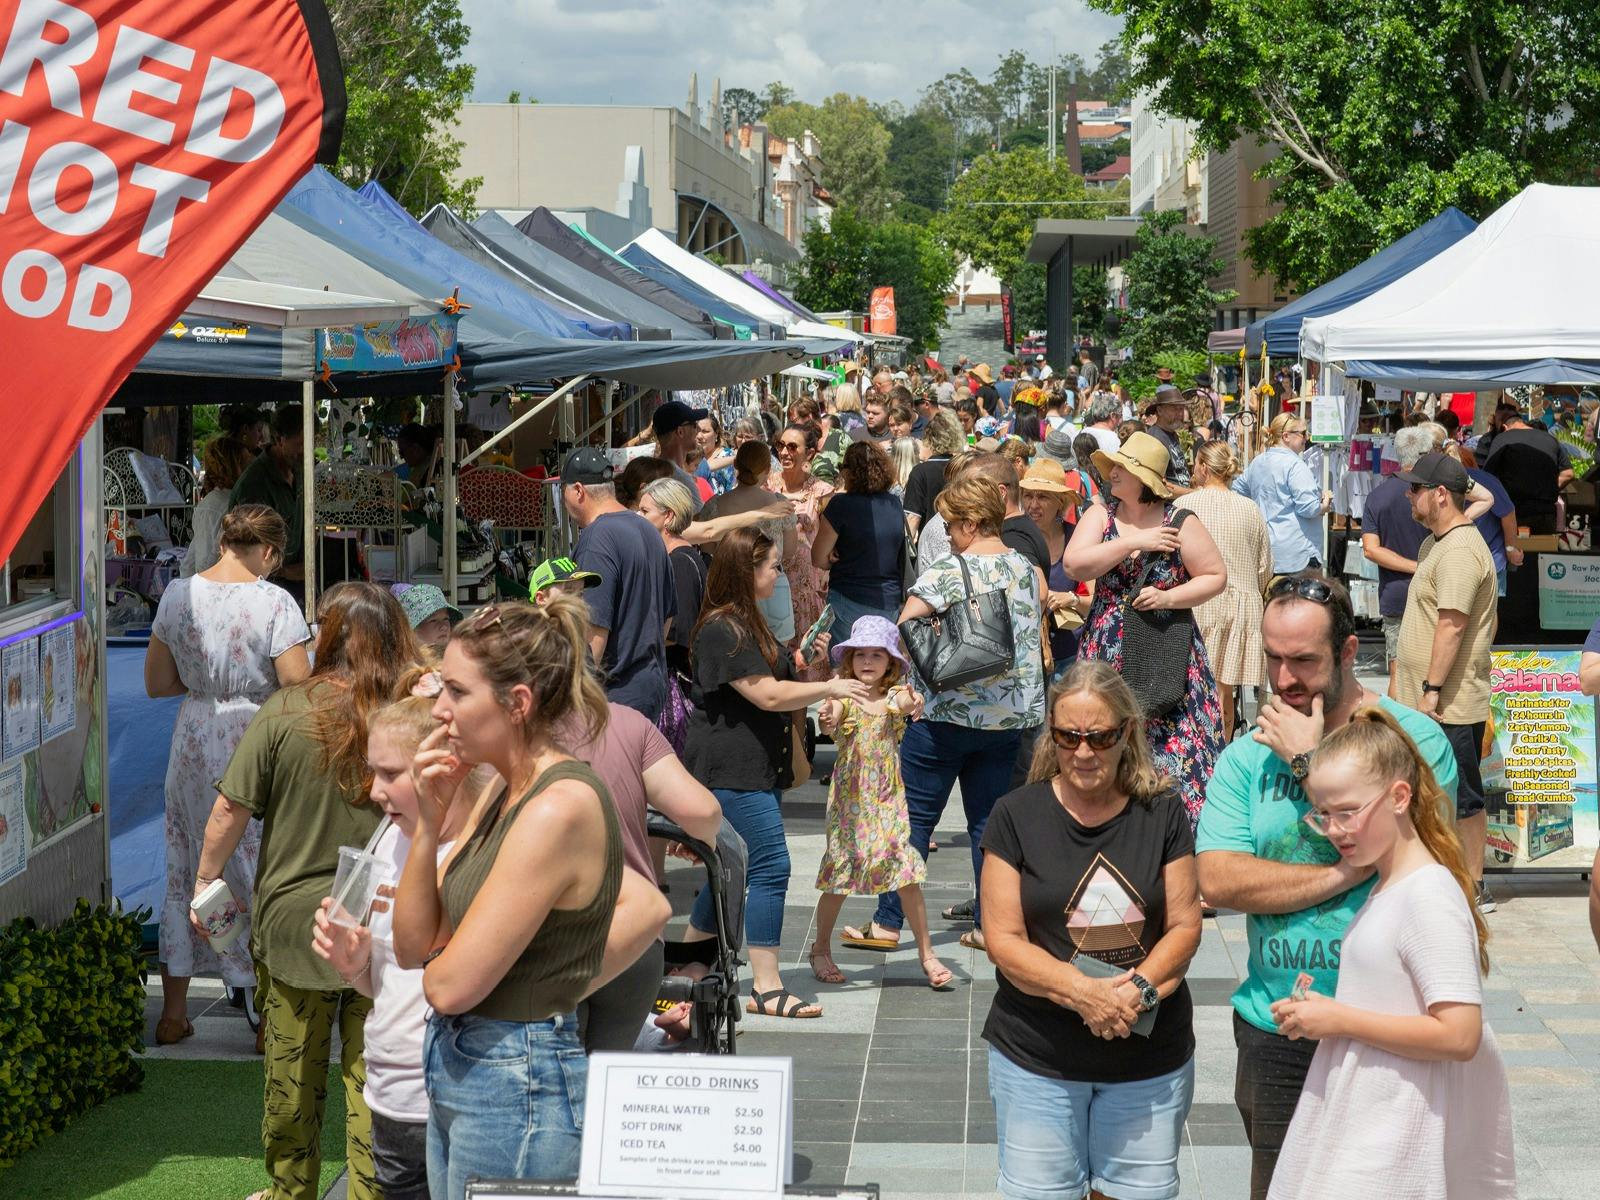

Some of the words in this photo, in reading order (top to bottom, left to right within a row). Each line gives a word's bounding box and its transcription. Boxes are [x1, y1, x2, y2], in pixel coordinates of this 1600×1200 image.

[1572, 564, 1587, 572] Raw
[1490, 651, 1553, 669] Tender
[1506, 699, 1553, 708] Marinated
[1554, 699, 1570, 708] for
[1513, 710, 1526, 719] 24
[1527, 710, 1553, 719] hours
[1554, 710, 1564, 719] in
[1508, 723, 1535, 733] Zesty
[1535, 723, 1570, 732] Lemon,
[1521, 734, 1548, 743] Garlic
[1549, 734, 1558, 743] &
[1513, 746, 1541, 755] Other
[1541, 746, 1567, 756] Tasty
[1505, 758, 1533, 766] Herbs
[1534, 758, 1542, 766] &
[1543, 758, 1576, 768] Spices.
[1505, 769, 1540, 779] Freshly
[1540, 769, 1576, 778] Cooked
[1260, 773, 1268, 803] I
[1523, 781, 1569, 790] Seasoned
[1507, 793, 1535, 802] Bread
[1536, 792, 1576, 802] Crumbs.
[1259, 936, 1265, 966] I
[637, 1074, 658, 1087] ICY
[665, 1075, 701, 1088] COLD
[709, 1076, 759, 1090] DRINKS
[622, 1104, 670, 1115] MINERAL
[672, 1105, 710, 1116] WATER
[735, 1106, 763, 1118] $2.50
[621, 1121, 647, 1131] SOFT
[650, 1122, 683, 1132] DRINK
[734, 1125, 763, 1136] $2.50
[620, 1139, 643, 1149] ICED
[646, 1139, 666, 1149] TEA
[733, 1143, 762, 1154] $4.00
[619, 1155, 648, 1163] Samples
[650, 1155, 657, 1163] of
[671, 1156, 692, 1165] drinks
[716, 1158, 729, 1166] the
[730, 1159, 748, 1167] small
[749, 1160, 767, 1168] table
[665, 1167, 683, 1175] front
[683, 1167, 691, 1175] of
[706, 1168, 720, 1176] stall
